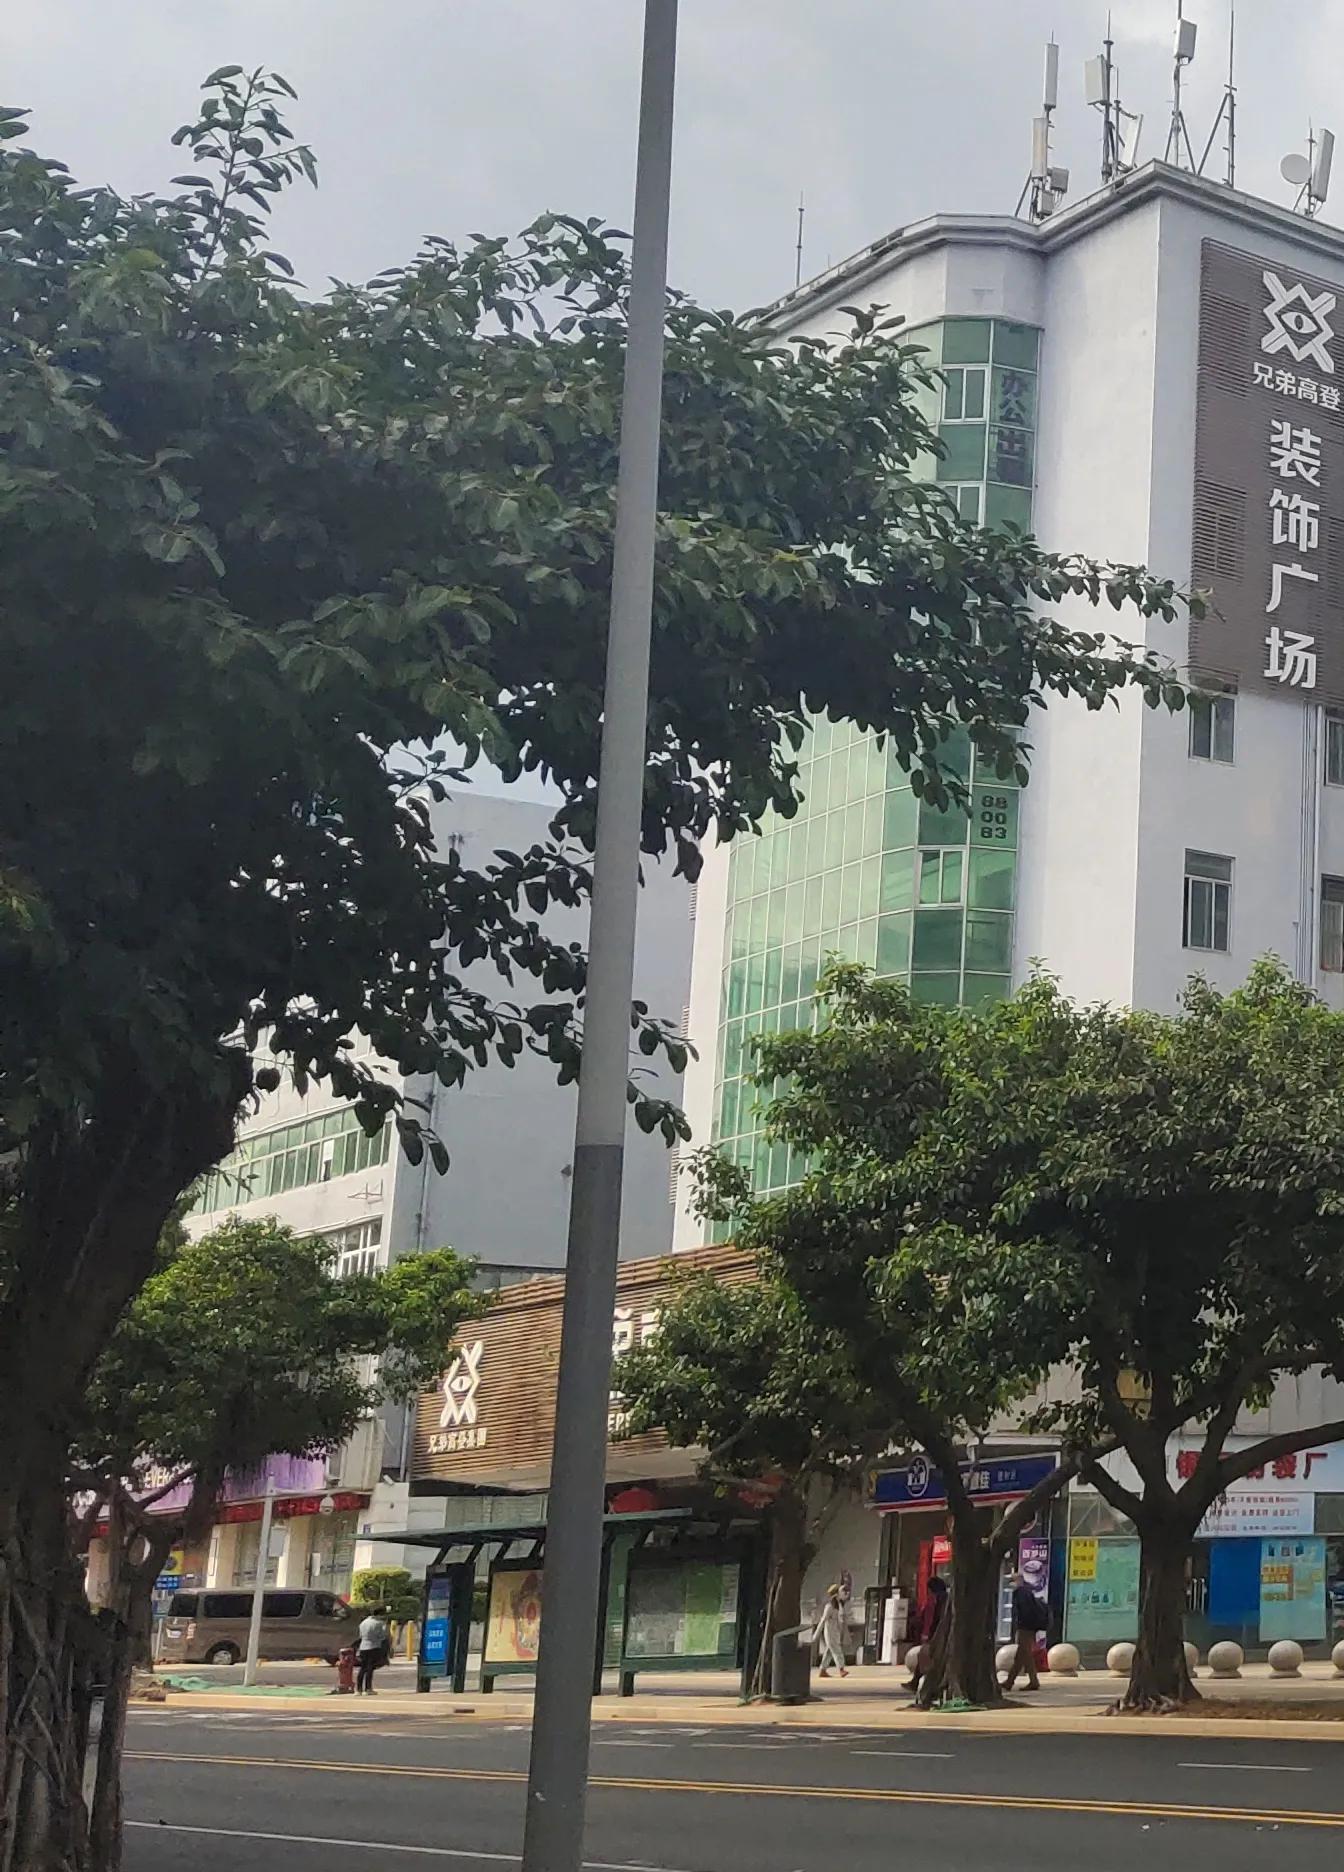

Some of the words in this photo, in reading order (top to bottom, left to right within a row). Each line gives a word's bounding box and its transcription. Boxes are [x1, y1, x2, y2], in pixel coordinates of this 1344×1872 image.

[1251, 360, 1342, 413] 兄弟高登
[1263, 418, 1323, 690] 装饰广场
